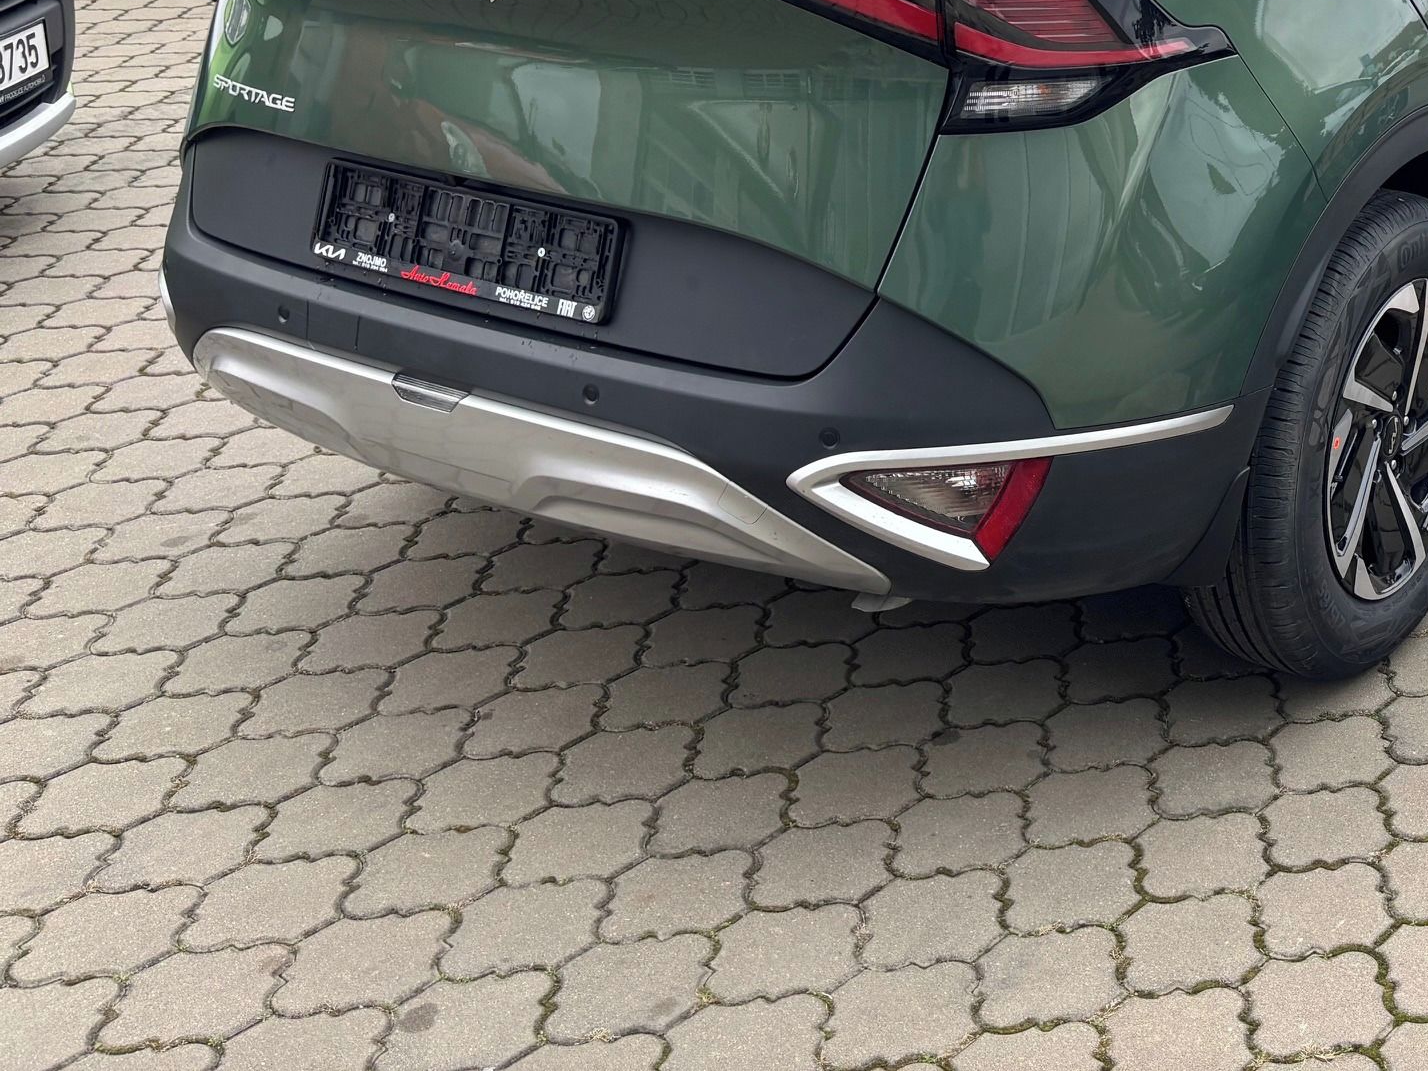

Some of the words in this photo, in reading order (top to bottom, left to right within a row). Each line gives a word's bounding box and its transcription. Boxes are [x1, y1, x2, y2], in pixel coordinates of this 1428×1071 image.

[212, 73, 296, 112] SPORTAGE
[313, 243, 346, 260] KIA
[356, 251, 387, 267] ZNOJMO
[495, 286, 549, 308] POHOŘELICE
[556, 298, 578, 318] FIAT
